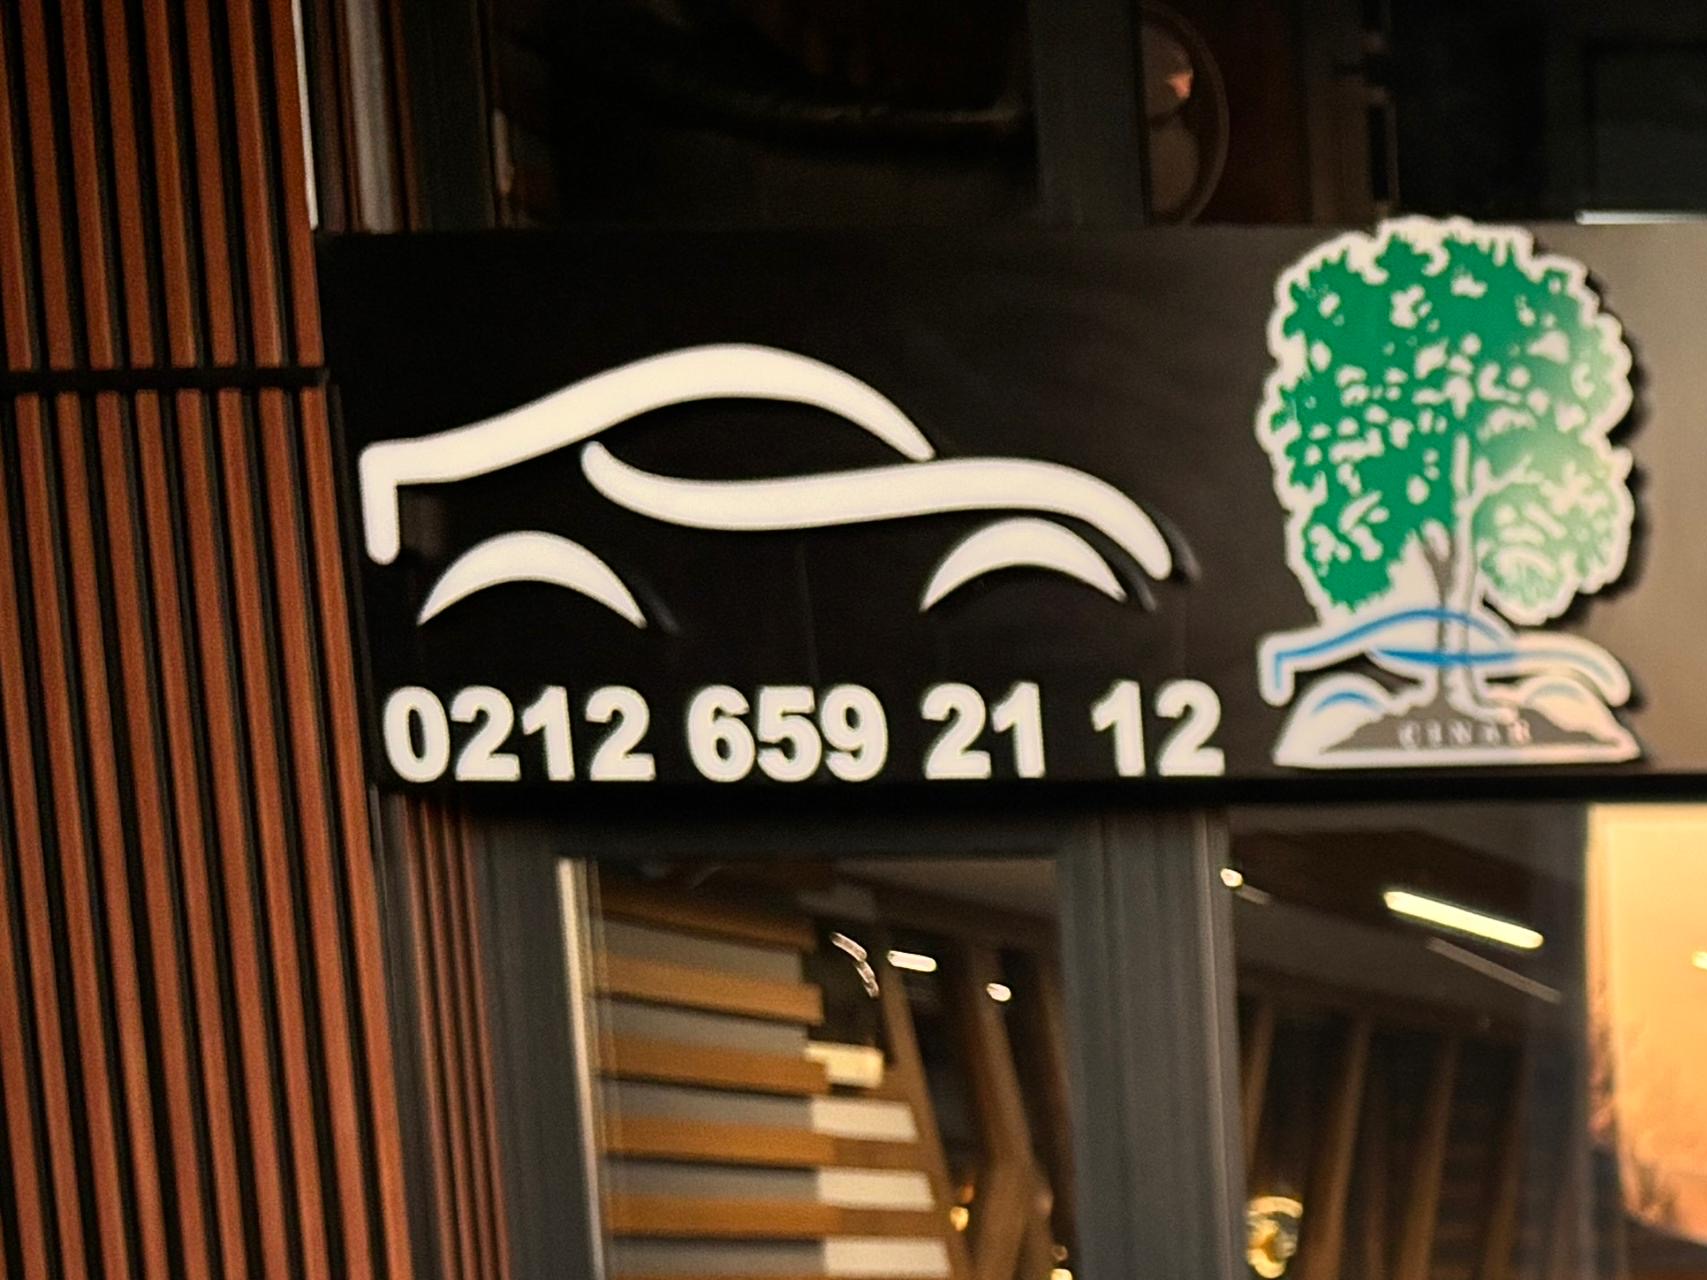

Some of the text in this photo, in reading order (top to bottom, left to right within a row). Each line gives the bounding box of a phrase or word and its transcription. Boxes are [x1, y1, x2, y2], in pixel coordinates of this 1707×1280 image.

[383, 680, 1226, 783] 0212 659 21 12
